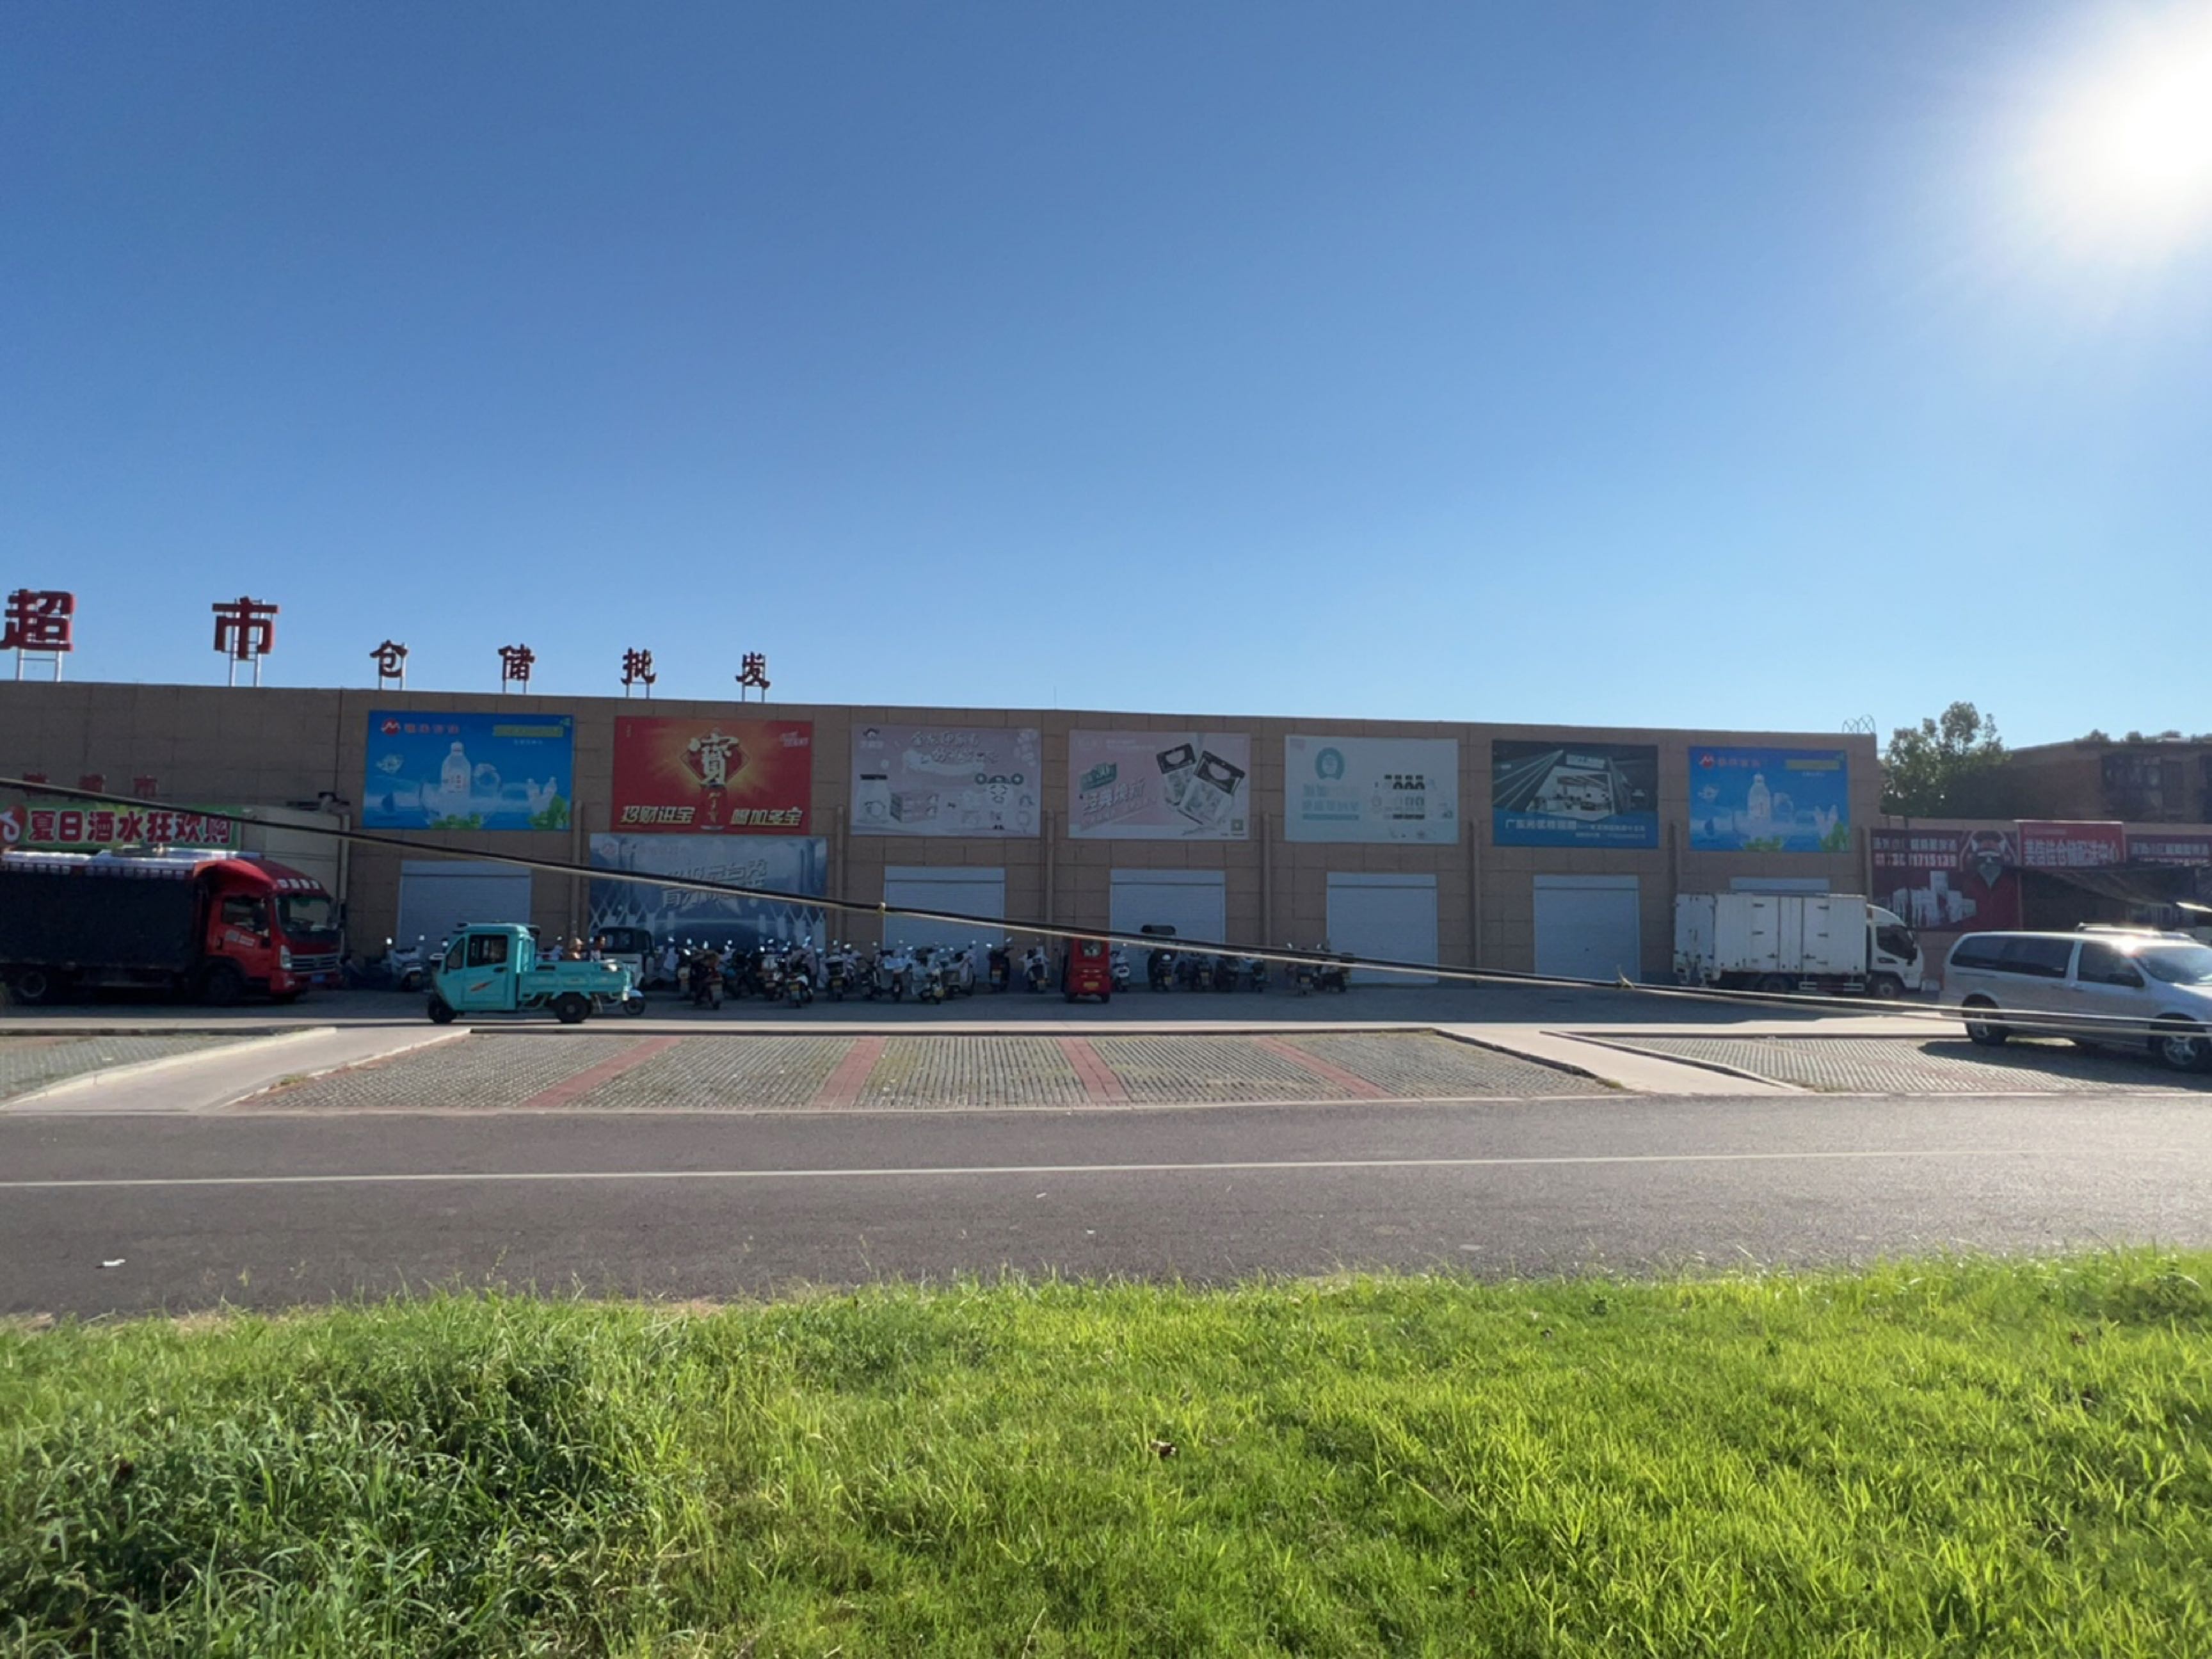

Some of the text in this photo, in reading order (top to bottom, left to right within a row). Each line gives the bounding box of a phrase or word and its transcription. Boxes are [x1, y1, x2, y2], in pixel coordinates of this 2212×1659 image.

[369, 639, 771, 690] 仓储批发
[28, 810, 232, 844] 夏日酒水狂欢购
